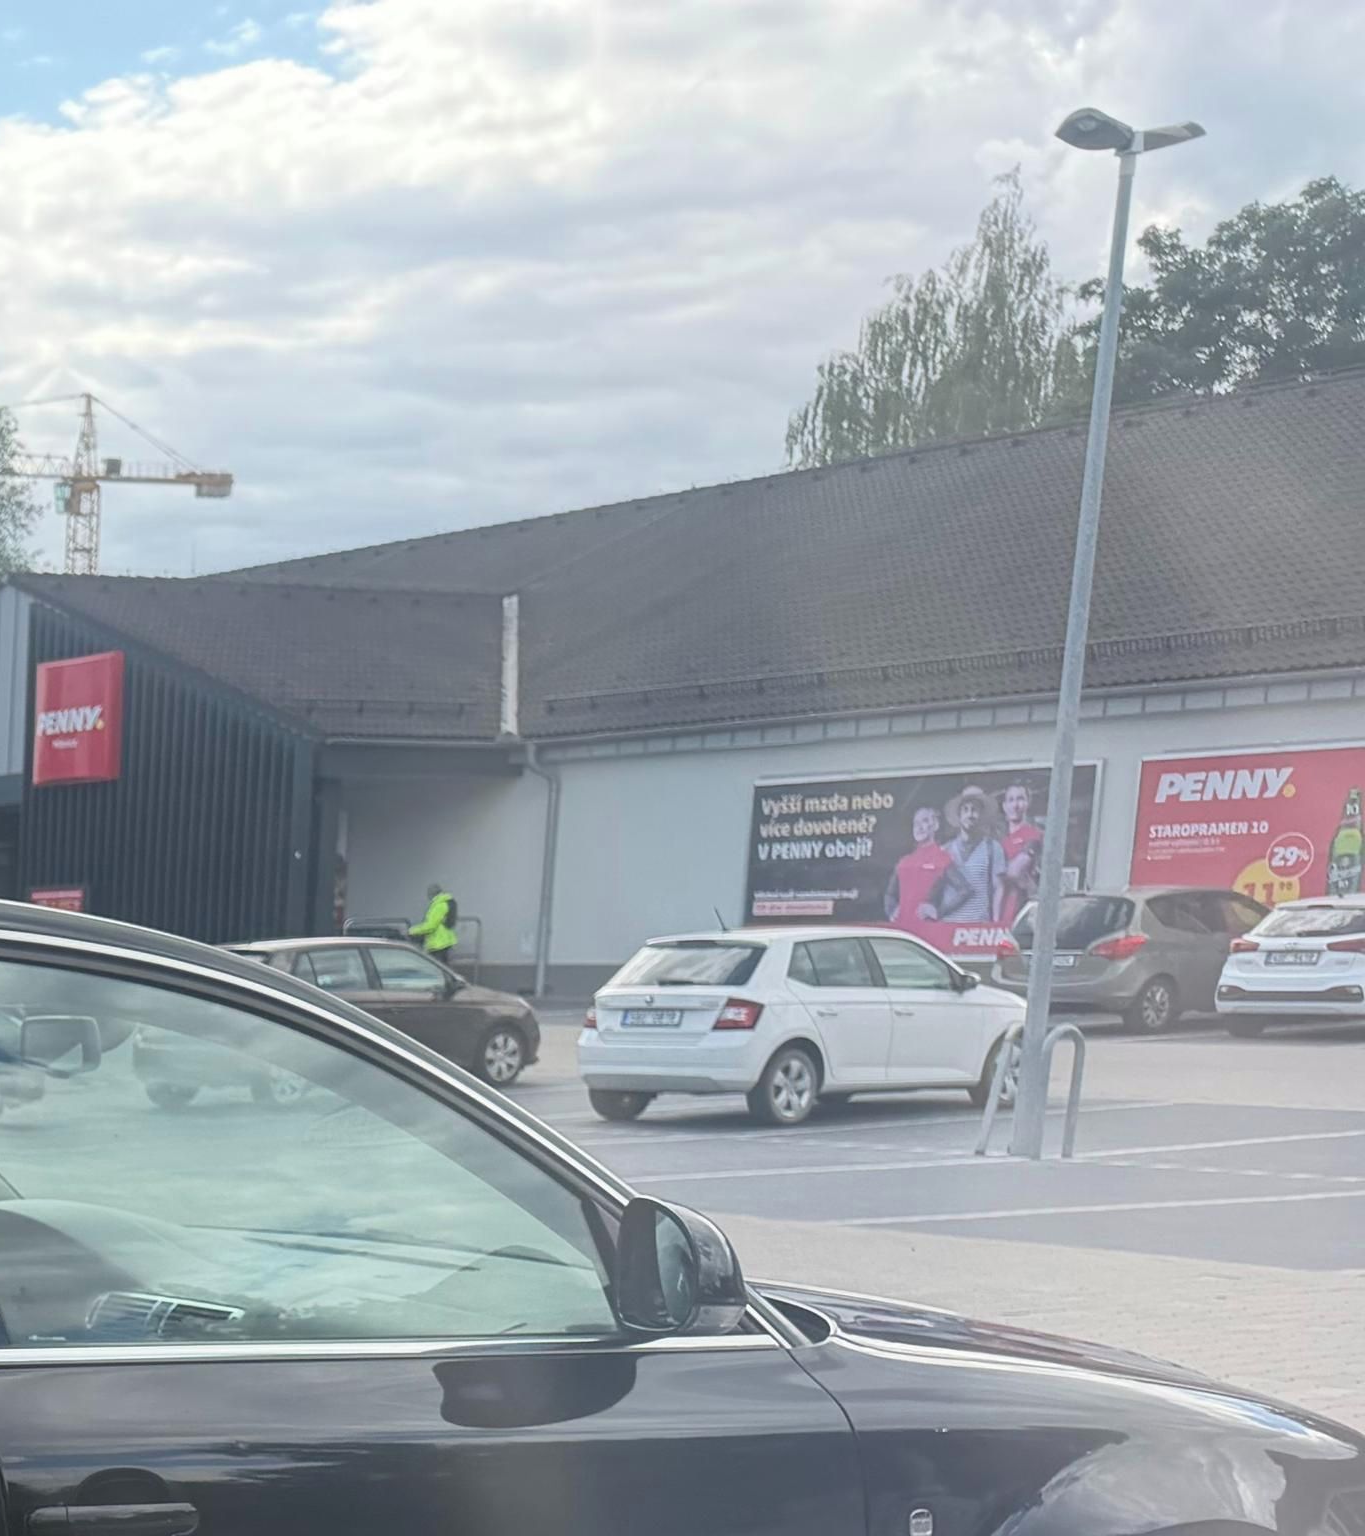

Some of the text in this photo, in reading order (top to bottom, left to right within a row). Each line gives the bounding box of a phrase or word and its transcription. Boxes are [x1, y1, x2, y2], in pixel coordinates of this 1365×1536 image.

[762, 790, 894, 818] Vyšší mzda nebo
[760, 813, 877, 838] více dovolené?
[1149, 820, 1269, 838] STAROPRAMEN 10
[758, 843, 770, 860] V
[771, 841, 823, 860] PENNY
[953, 927, 1015, 946] PENN
